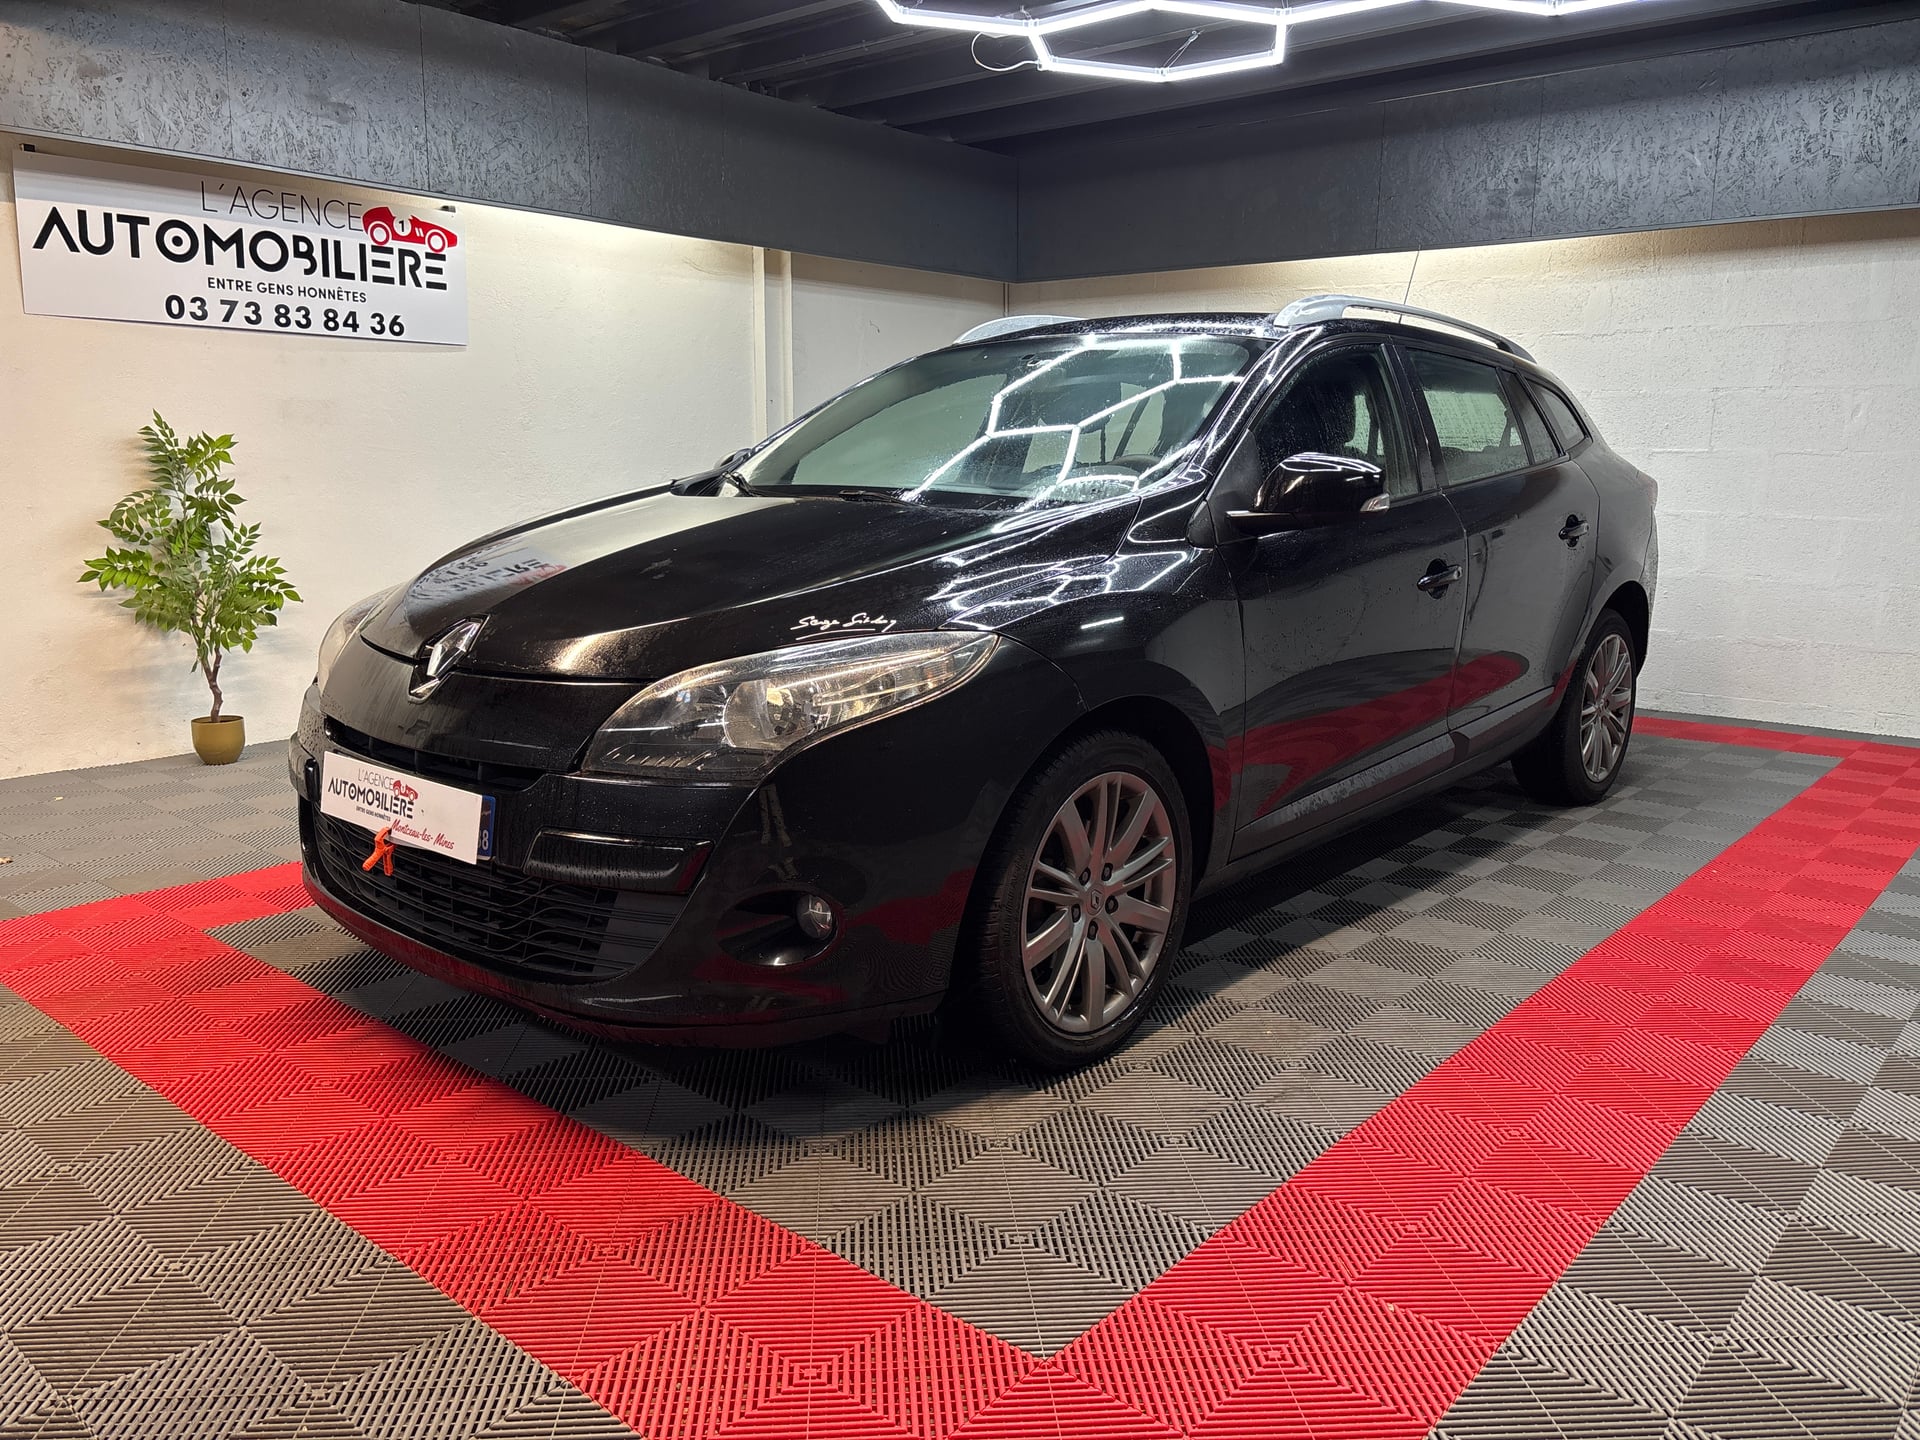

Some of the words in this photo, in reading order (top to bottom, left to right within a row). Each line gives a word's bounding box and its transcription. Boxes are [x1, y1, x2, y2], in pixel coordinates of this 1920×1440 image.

[200, 180, 363, 233] L'AGENCE
[207, 277, 253, 292] ENTRE
[256, 281, 293, 297] GENS
[297, 285, 367, 304] HONNÊTES
[165, 294, 209, 321] 03
[219, 299, 262, 325] 73
[274, 303, 312, 329] 83
[323, 308, 360, 333] 84
[369, 312, 405, 337] 36
[358, 767, 394, 790] L'AGENCE
